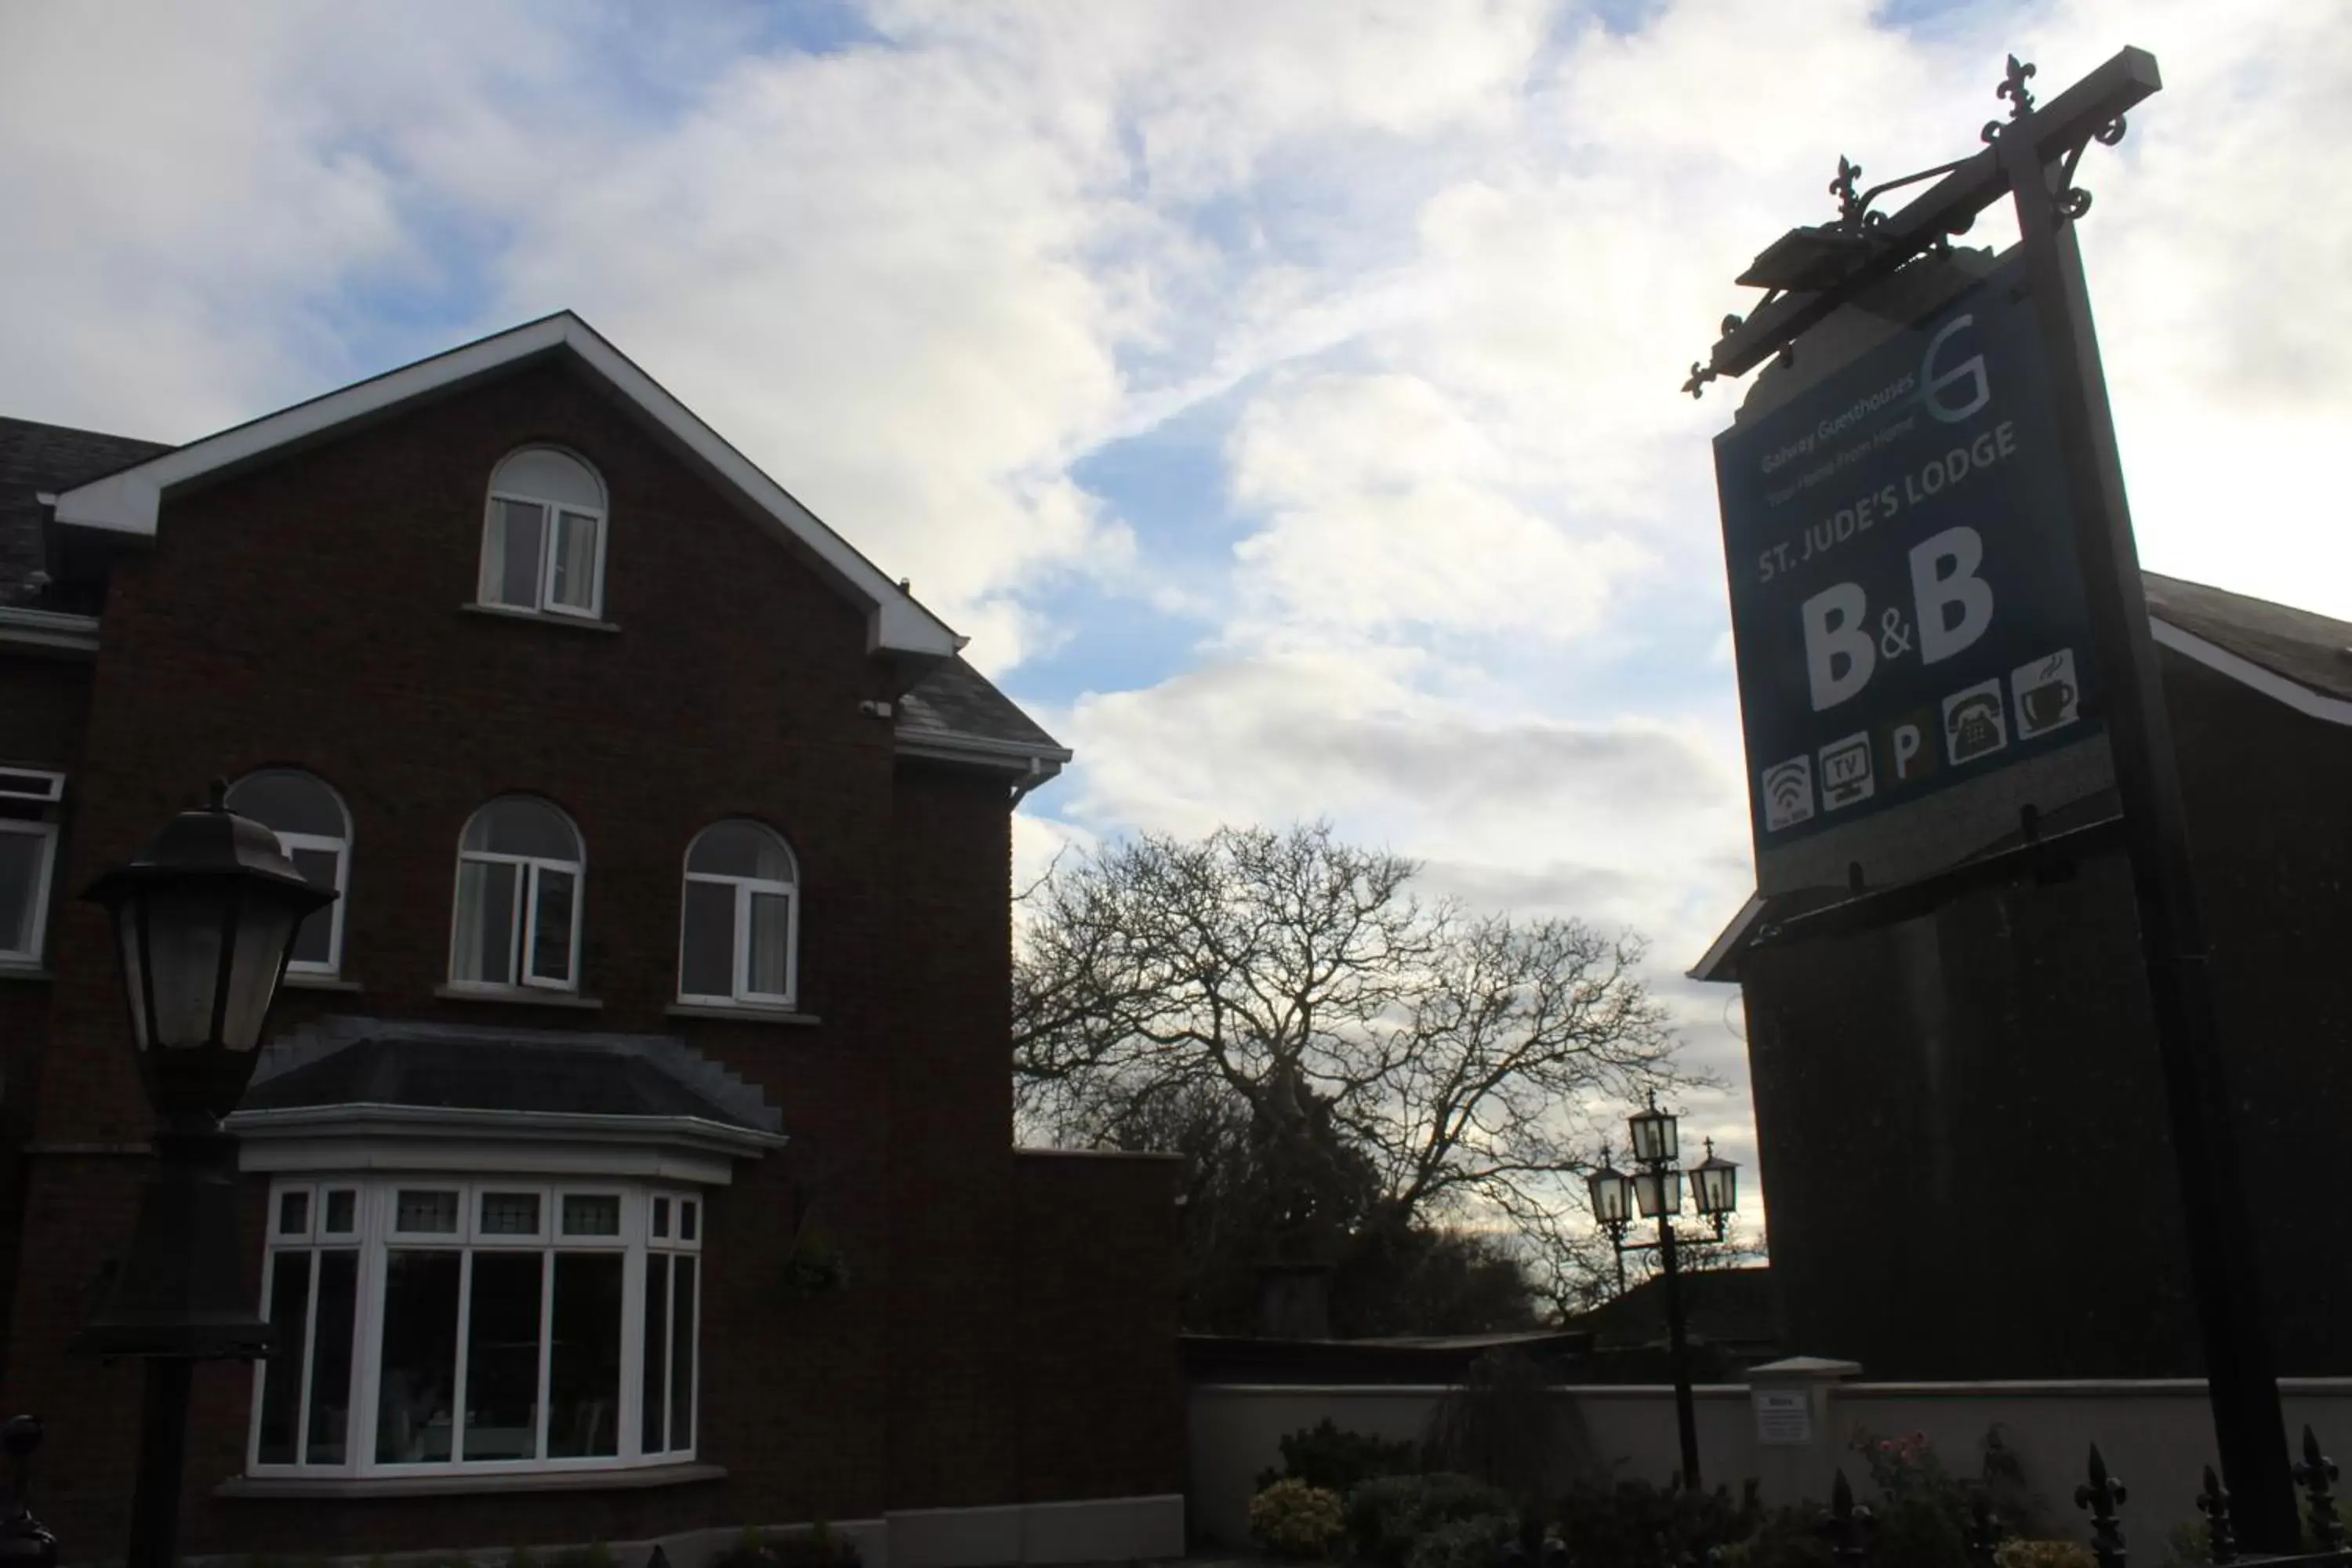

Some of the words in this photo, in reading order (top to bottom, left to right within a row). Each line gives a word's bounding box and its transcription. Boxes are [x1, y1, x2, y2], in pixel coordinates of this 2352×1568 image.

[1761, 432, 1814, 474] Galway
[1817, 372, 1915, 441] Guesthouses
[1759, 541, 1796, 583] ST.
[1802, 485, 1899, 561] JUDE'S
[1906, 421, 2017, 506] LODGE
[1832, 753, 1857, 779] TV
[1893, 724, 1920, 779] P
